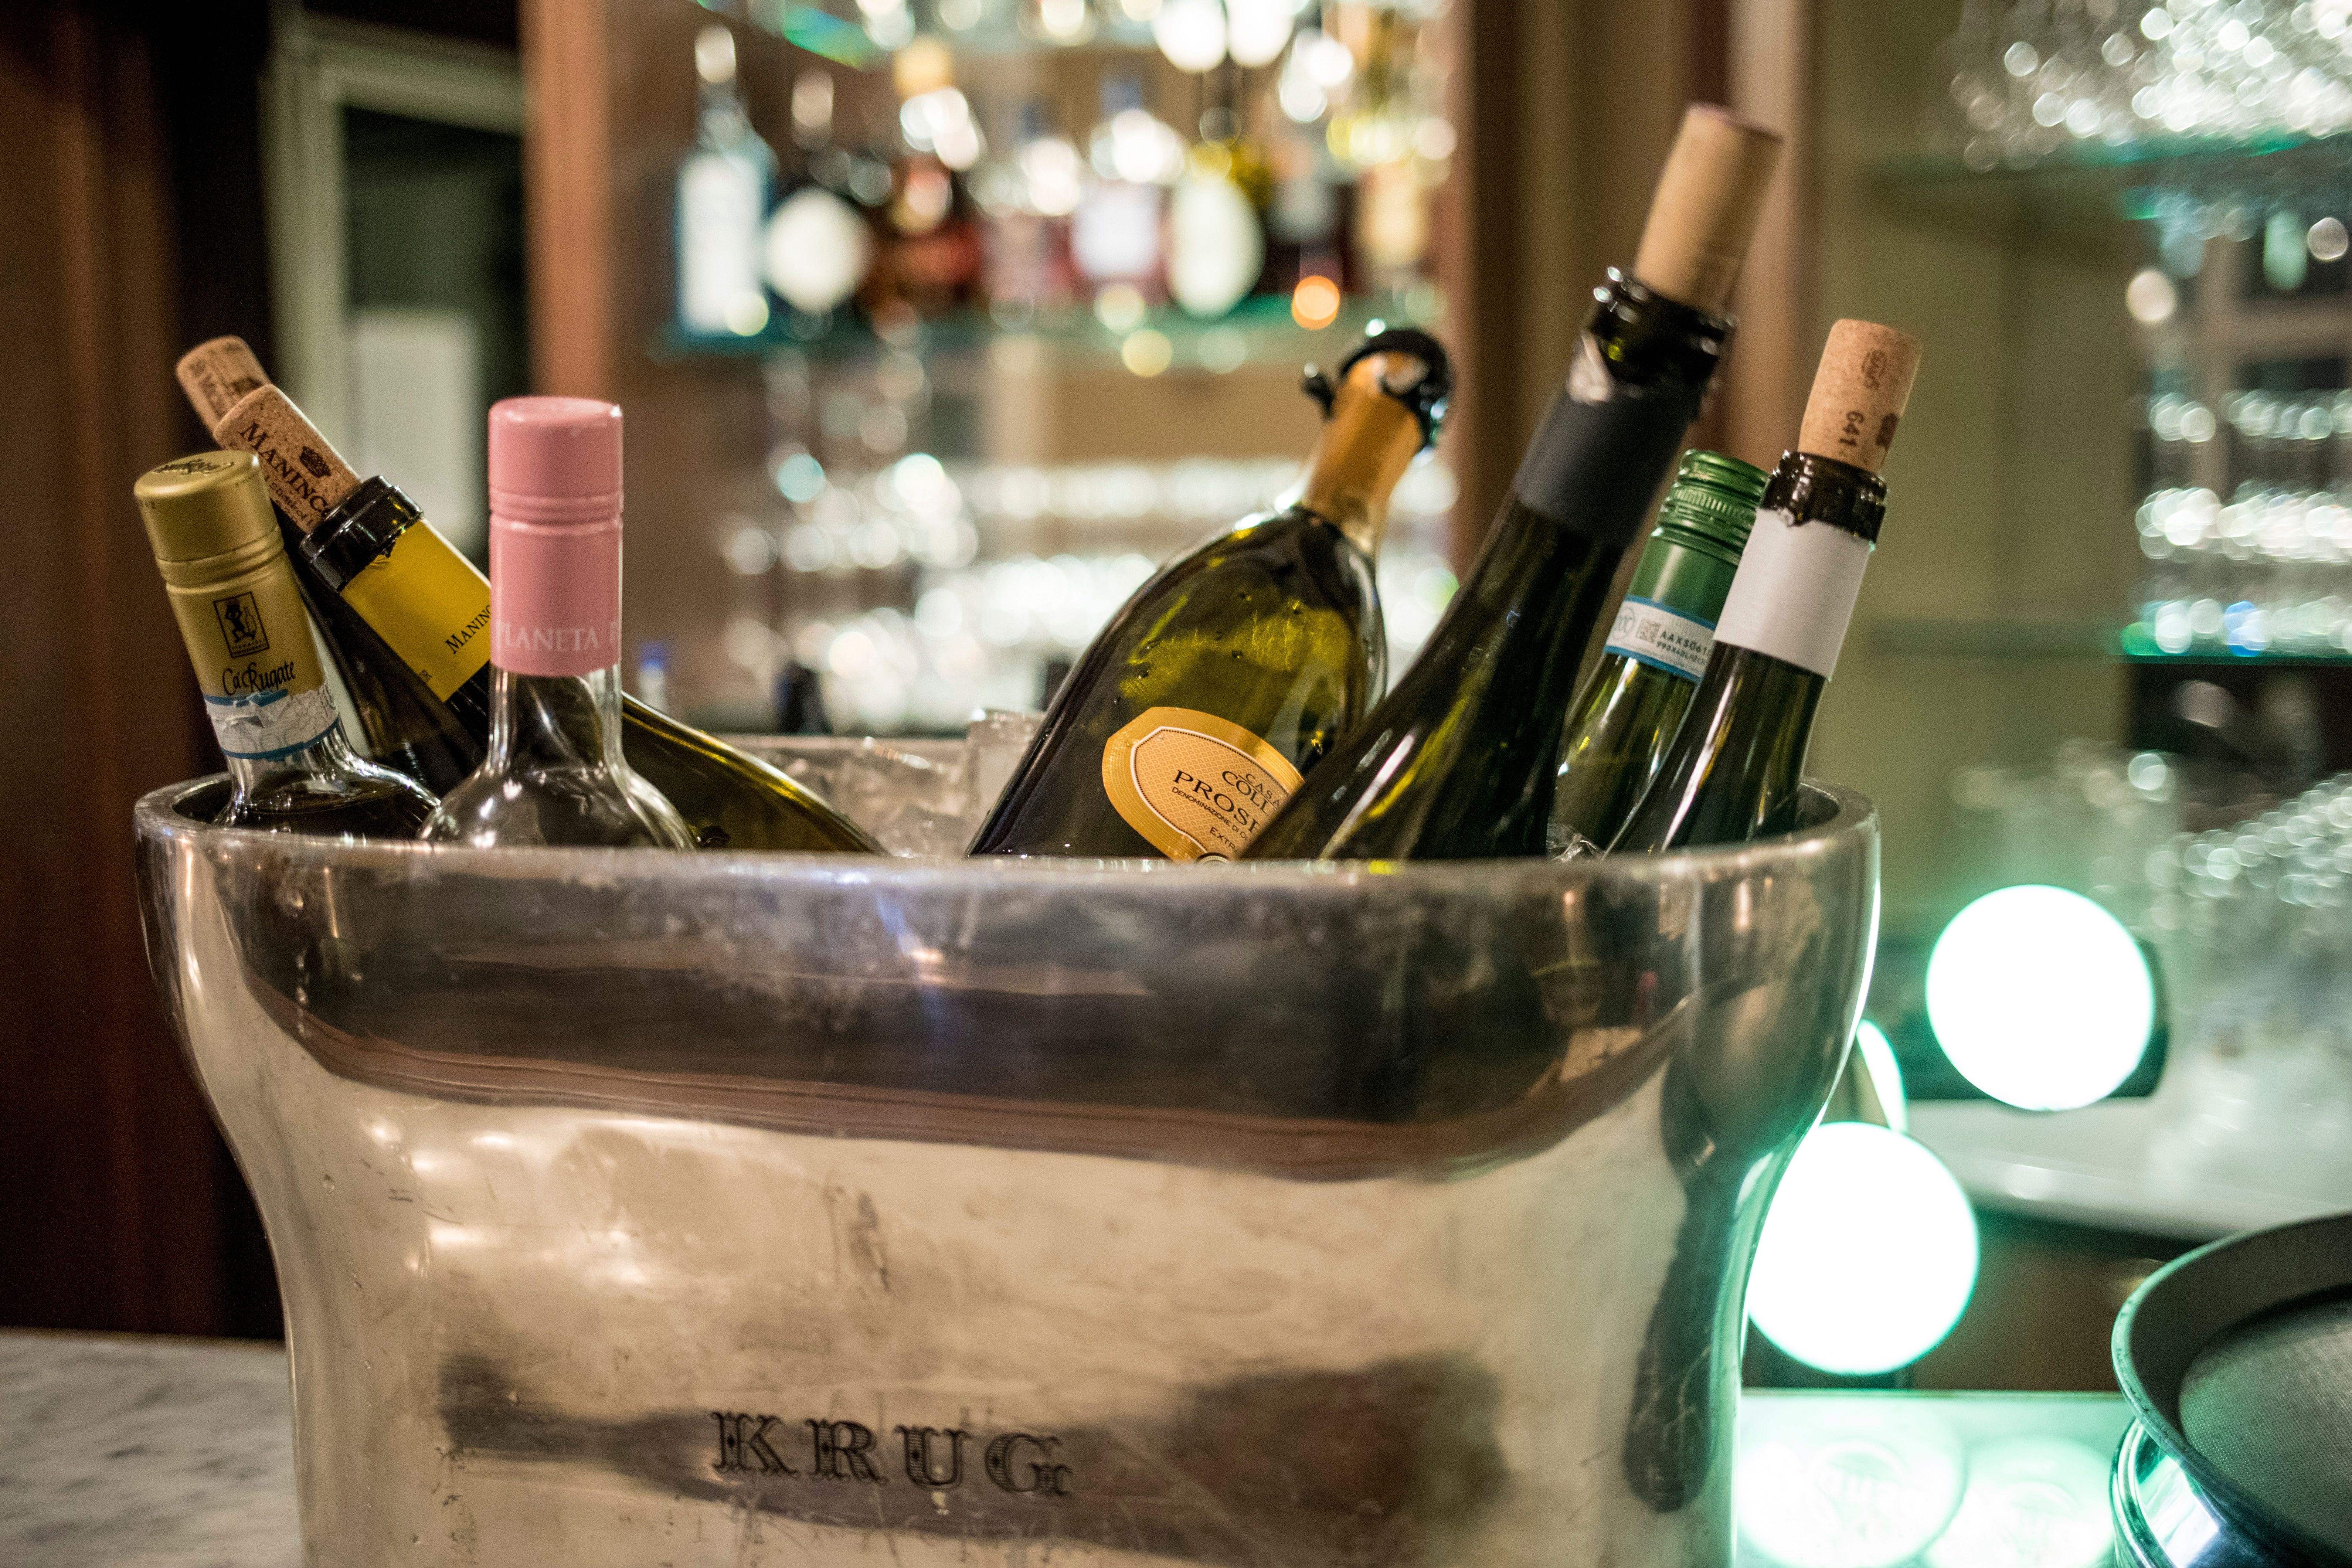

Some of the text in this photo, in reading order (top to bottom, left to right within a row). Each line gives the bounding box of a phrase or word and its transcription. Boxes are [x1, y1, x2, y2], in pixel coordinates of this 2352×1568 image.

[238, 419, 330, 517] MANINC
[241, 661, 296, 693] Rugate
[1172, 787, 1231, 826] DENOMINAZIONE
[1232, 824, 1239, 833] DI
[1210, 826, 1237, 852] EXTR
[710, 1411, 1073, 1497] KRUG
